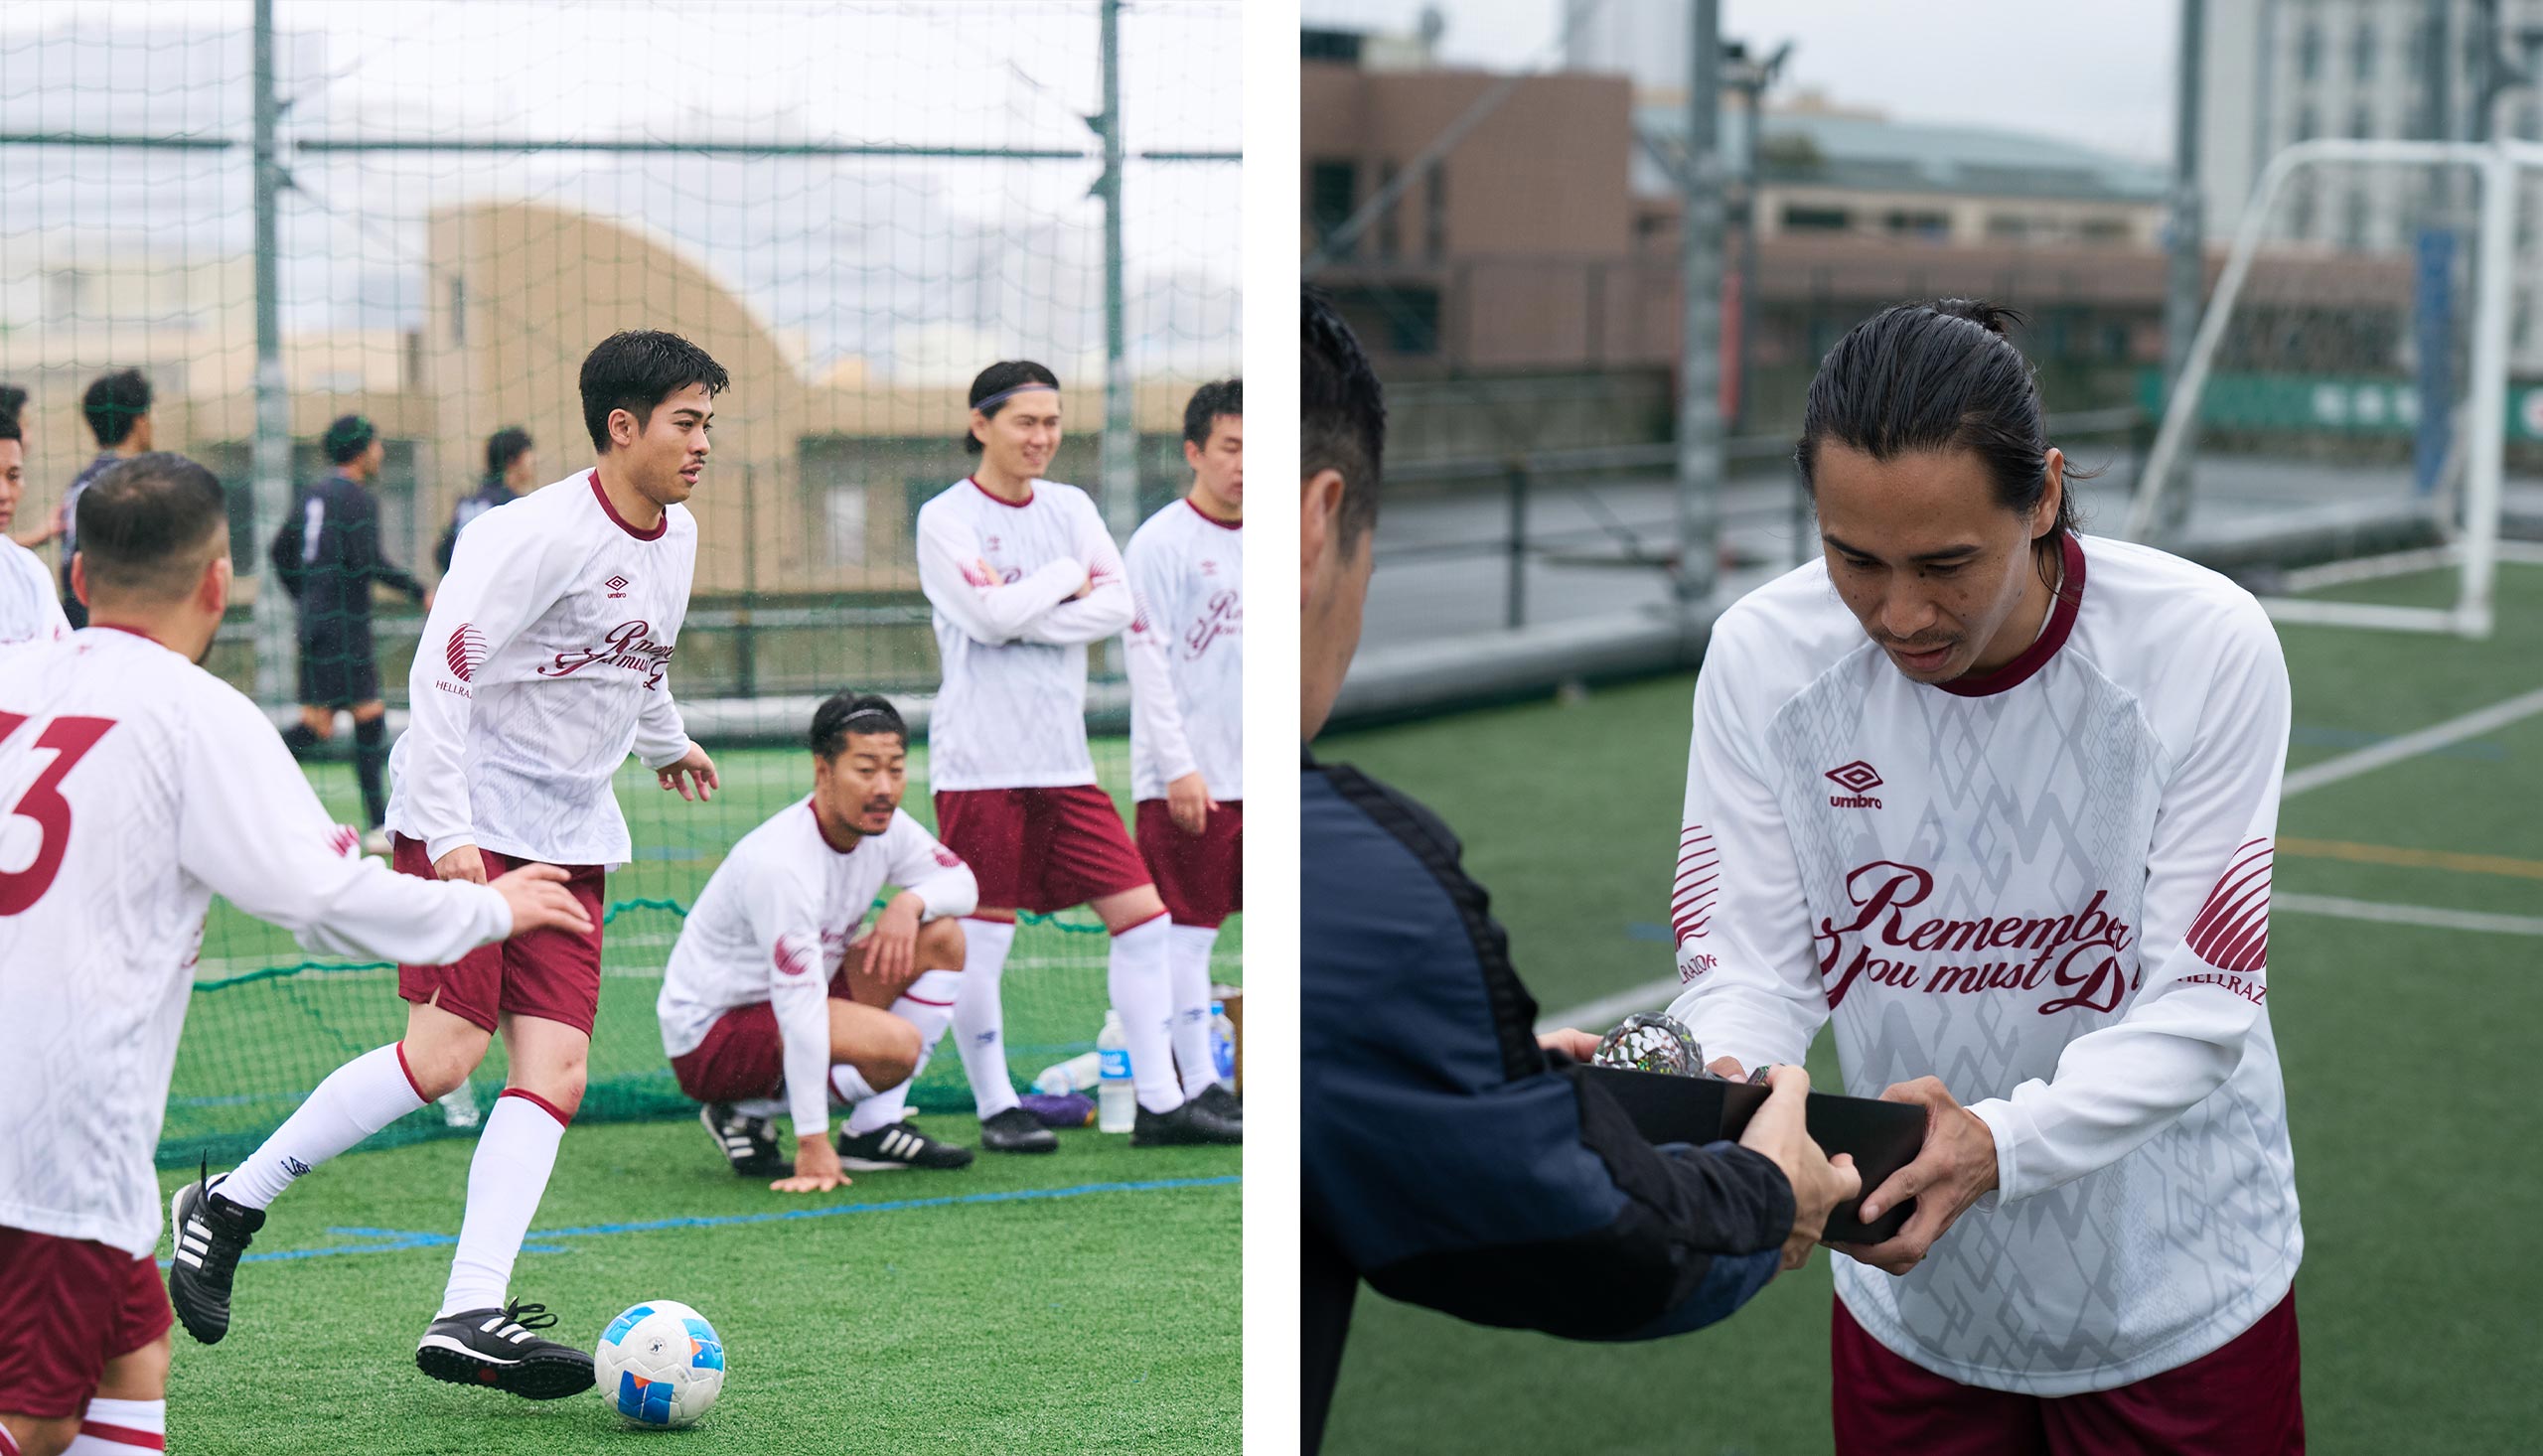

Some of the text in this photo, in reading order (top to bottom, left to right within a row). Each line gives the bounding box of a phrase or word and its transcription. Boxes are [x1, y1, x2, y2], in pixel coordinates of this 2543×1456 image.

[436, 680, 472, 699] HELLRA
[0, 709, 117, 917] 3
[1830, 795, 1882, 809] umbro
[1822, 860, 2133, 952] Remember
[1681, 953, 1718, 984] RAZOR
[1814, 917, 1920, 1011] You
[1923, 945, 2053, 994] must
